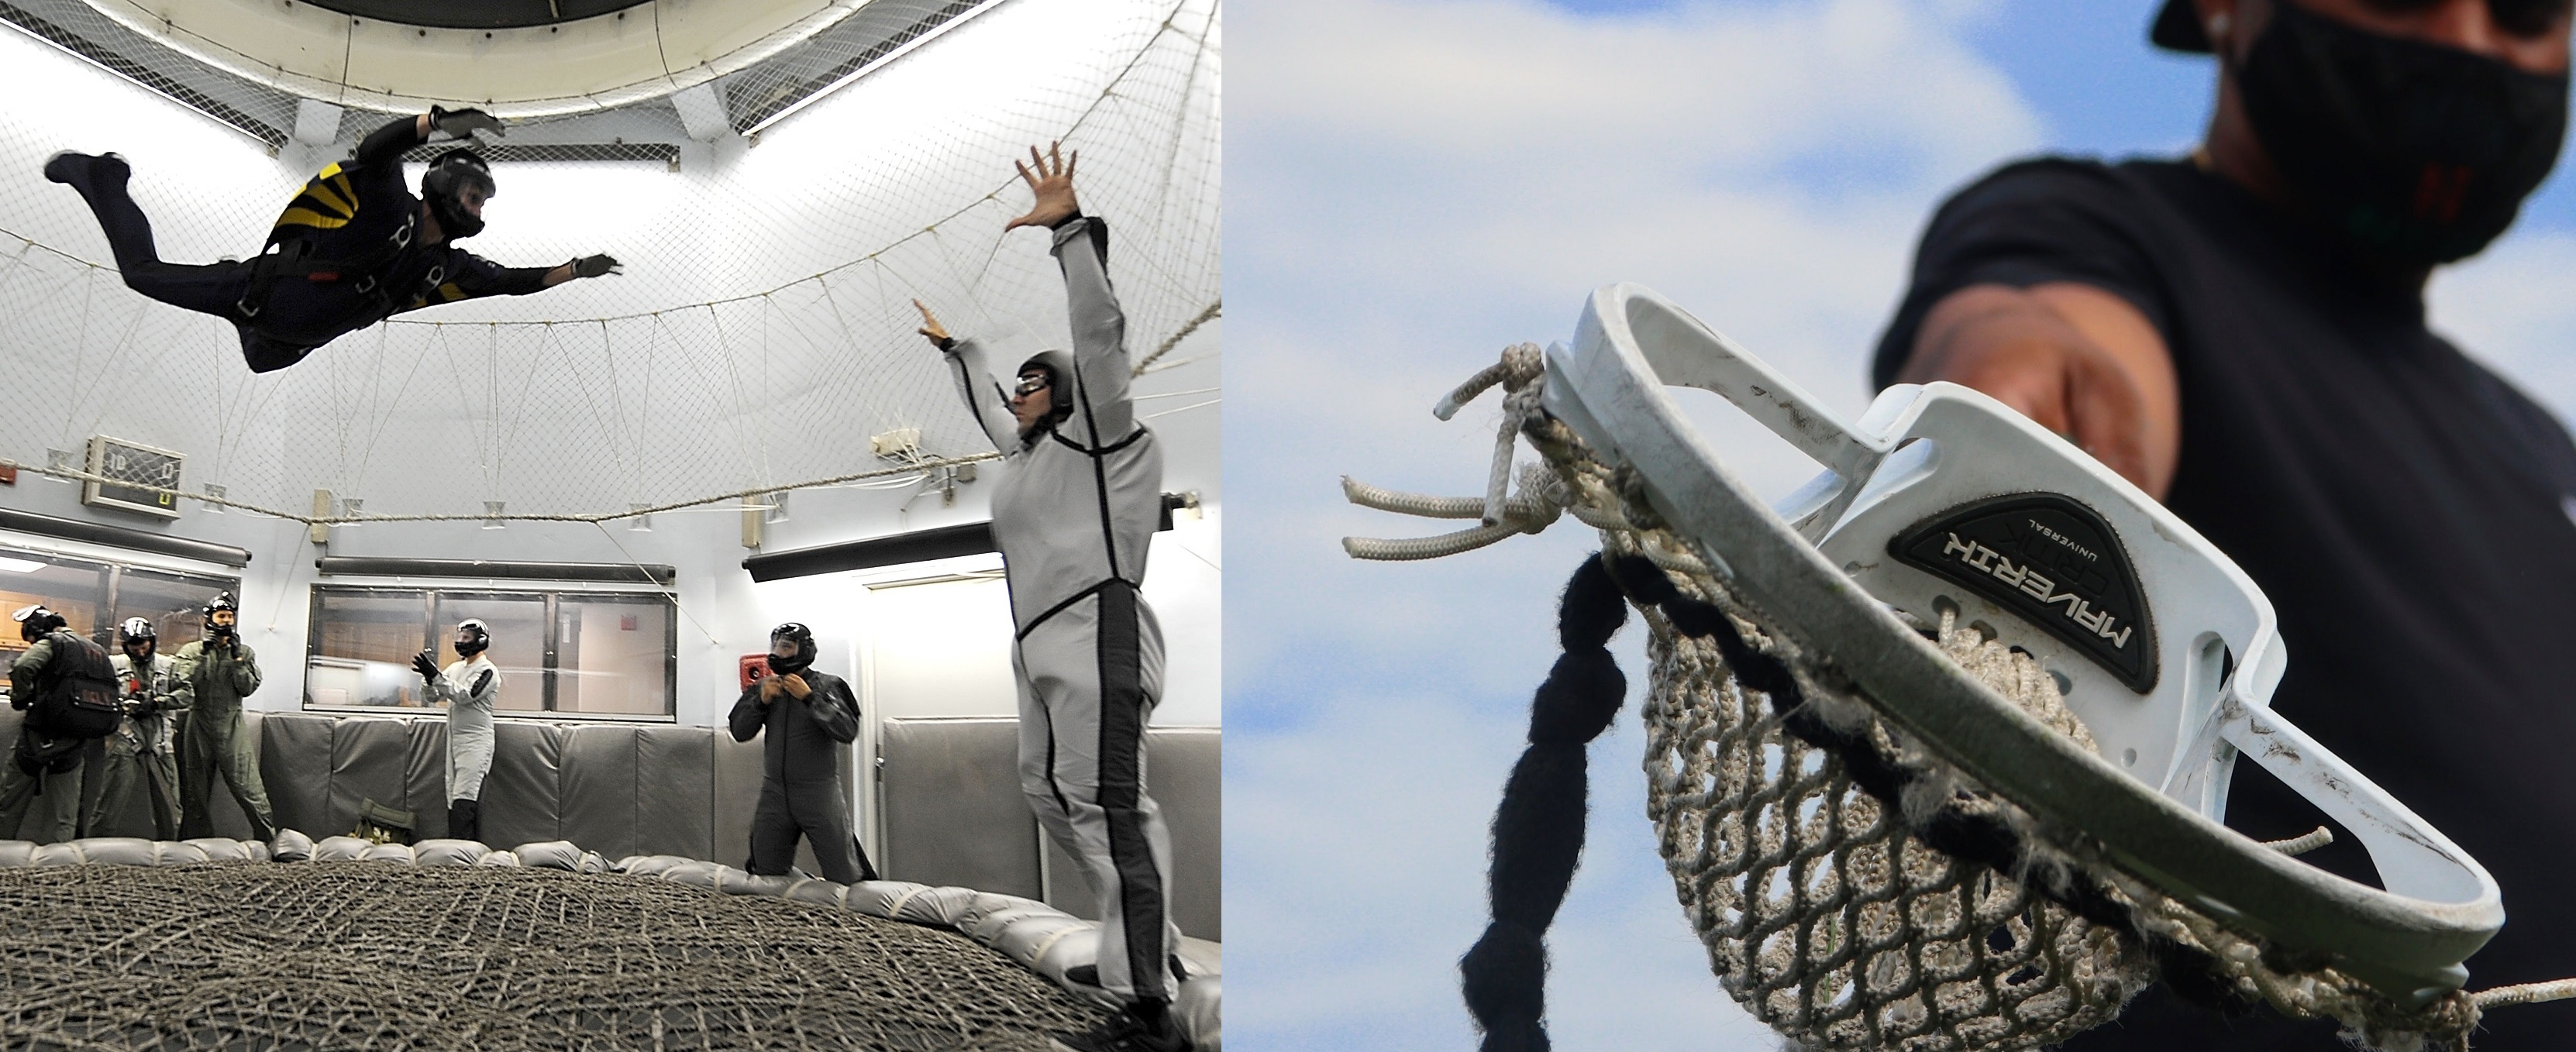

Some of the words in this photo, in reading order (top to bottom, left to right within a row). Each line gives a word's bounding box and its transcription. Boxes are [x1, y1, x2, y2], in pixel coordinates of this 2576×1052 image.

[1997, 523, 2109, 597] CRITIK
[2028, 518, 2098, 562] UNIVERSAL
[1944, 532, 2133, 649] MAVERIK
